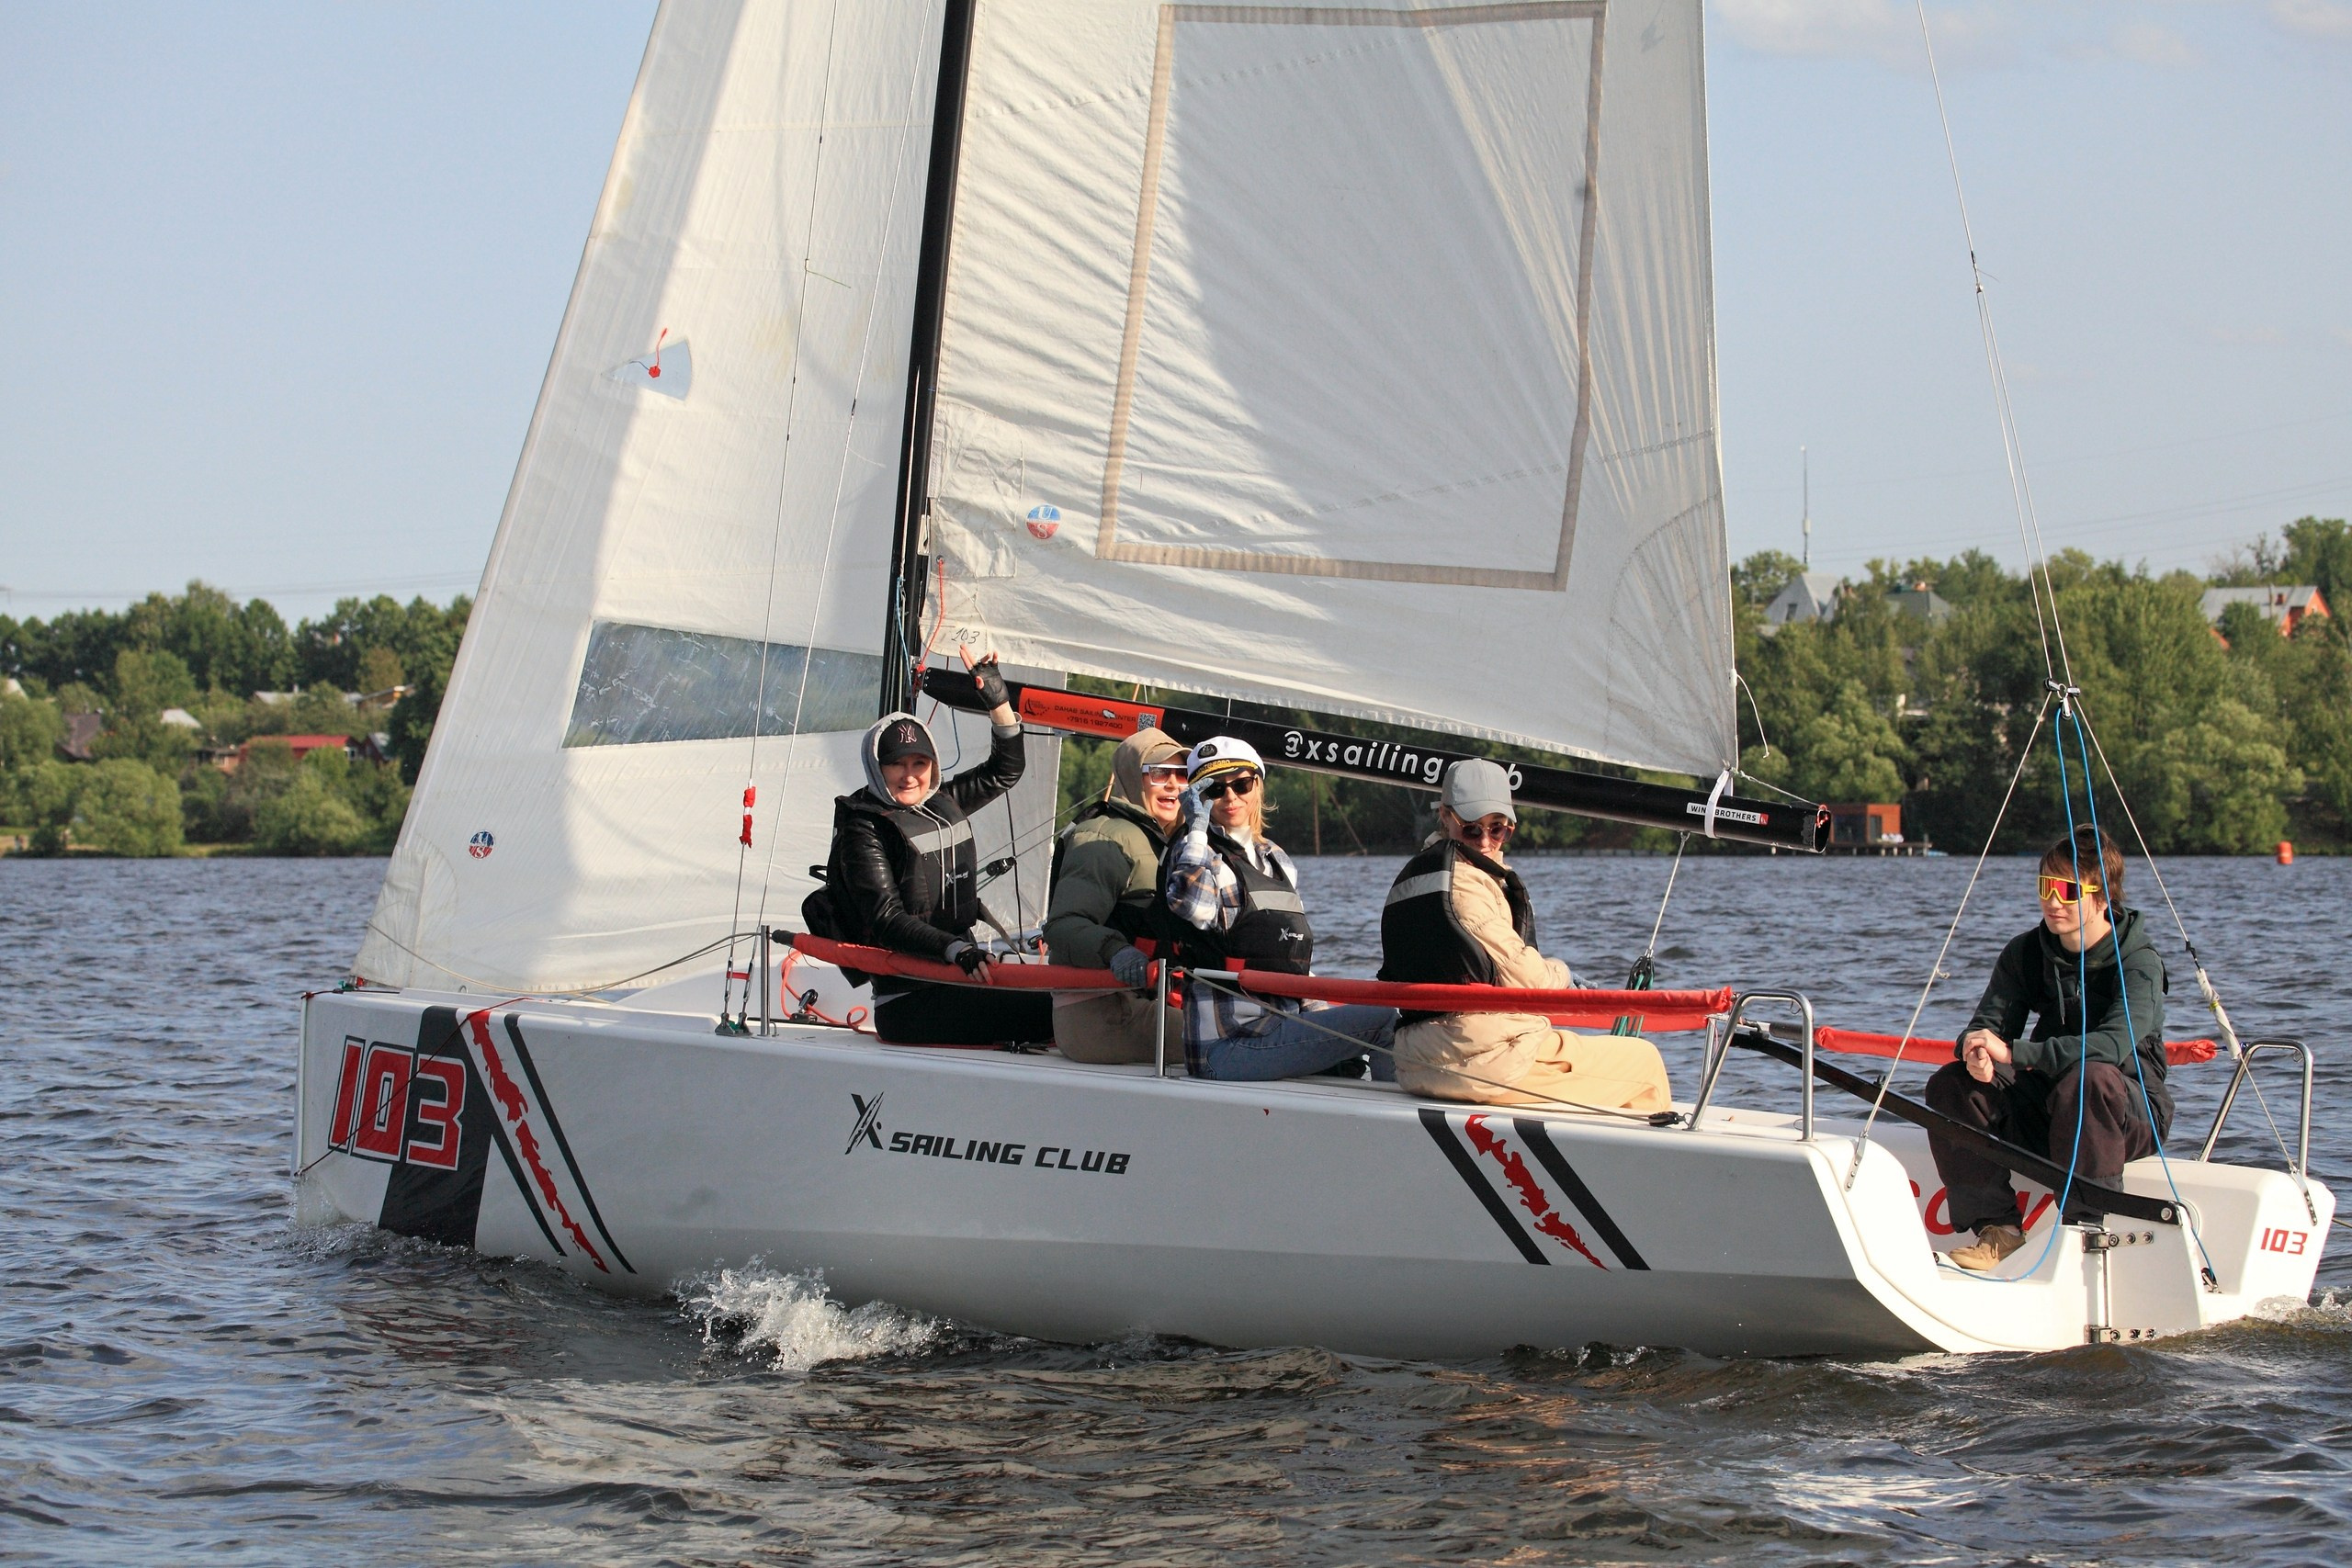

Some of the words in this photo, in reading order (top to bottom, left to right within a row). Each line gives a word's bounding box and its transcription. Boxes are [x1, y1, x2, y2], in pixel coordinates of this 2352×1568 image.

[951, 627, 980, 644] 103
[1054, 705, 1078, 714] DAHAB
[1080, 708, 1104, 717] SAILIN
[1114, 714, 1136, 723] ENTER
[1284, 730, 1523, 791] @xsailingb
[1690, 805, 1707, 814] WIN
[1715, 809, 1757, 821] BROTHERS
[328, 1035, 467, 1171] 103
[888, 1132, 1026, 1166] SAILING
[1035, 1146, 1131, 1174] CLUB
[2260, 1227, 2308, 1255] 103
